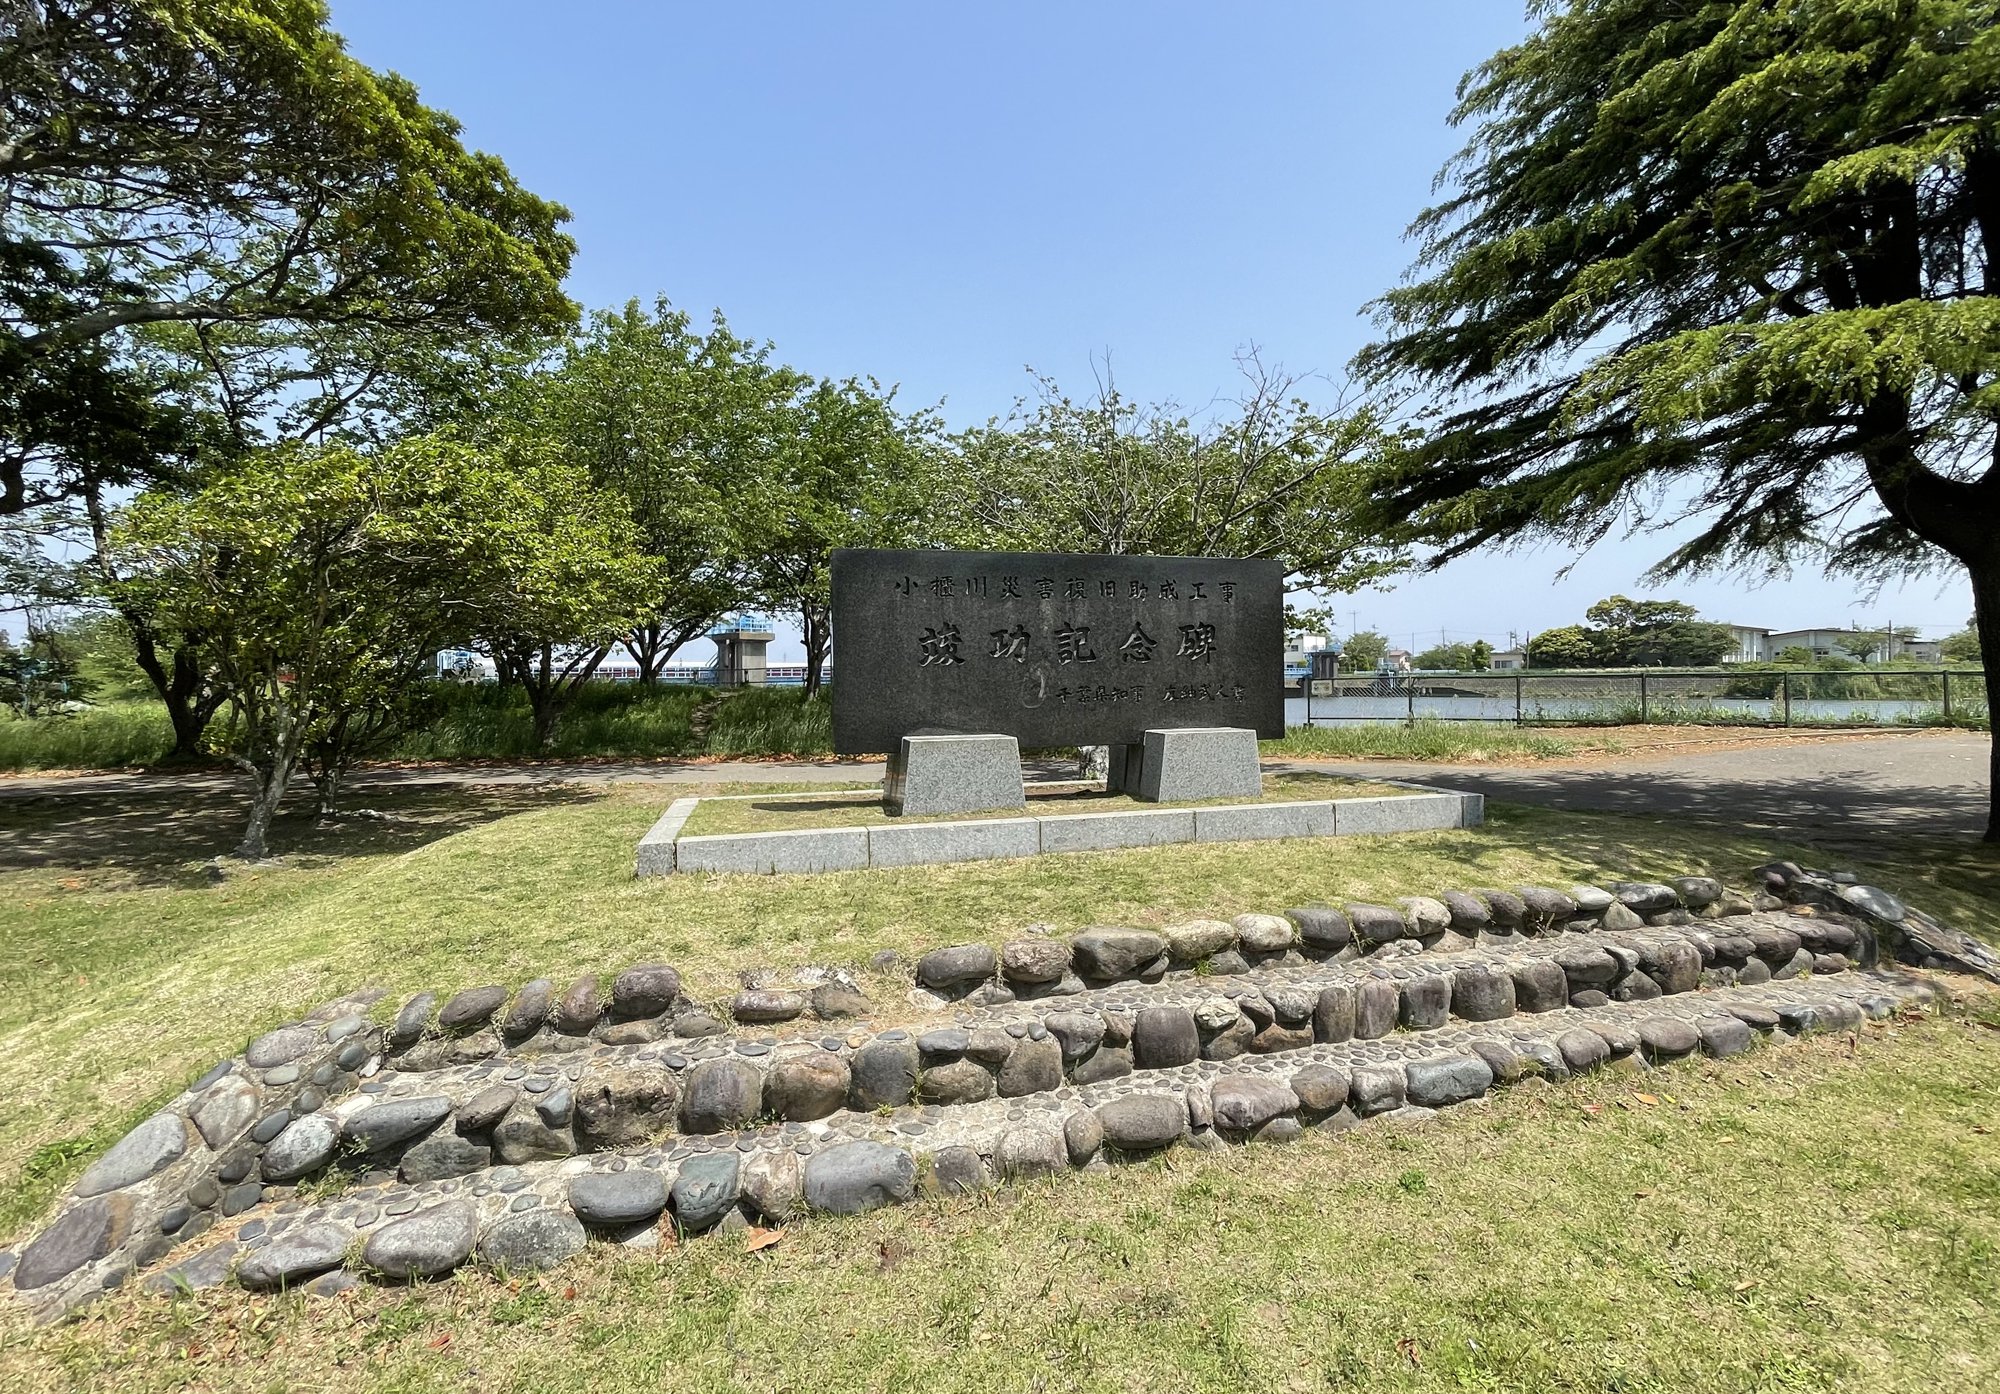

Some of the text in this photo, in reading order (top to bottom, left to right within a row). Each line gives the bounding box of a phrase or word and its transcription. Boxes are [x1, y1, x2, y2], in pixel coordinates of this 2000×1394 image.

[895, 575, 1237, 603] 小櫃川災害復旧助成工事
[918, 621, 1217, 667] 竣功記念碑
